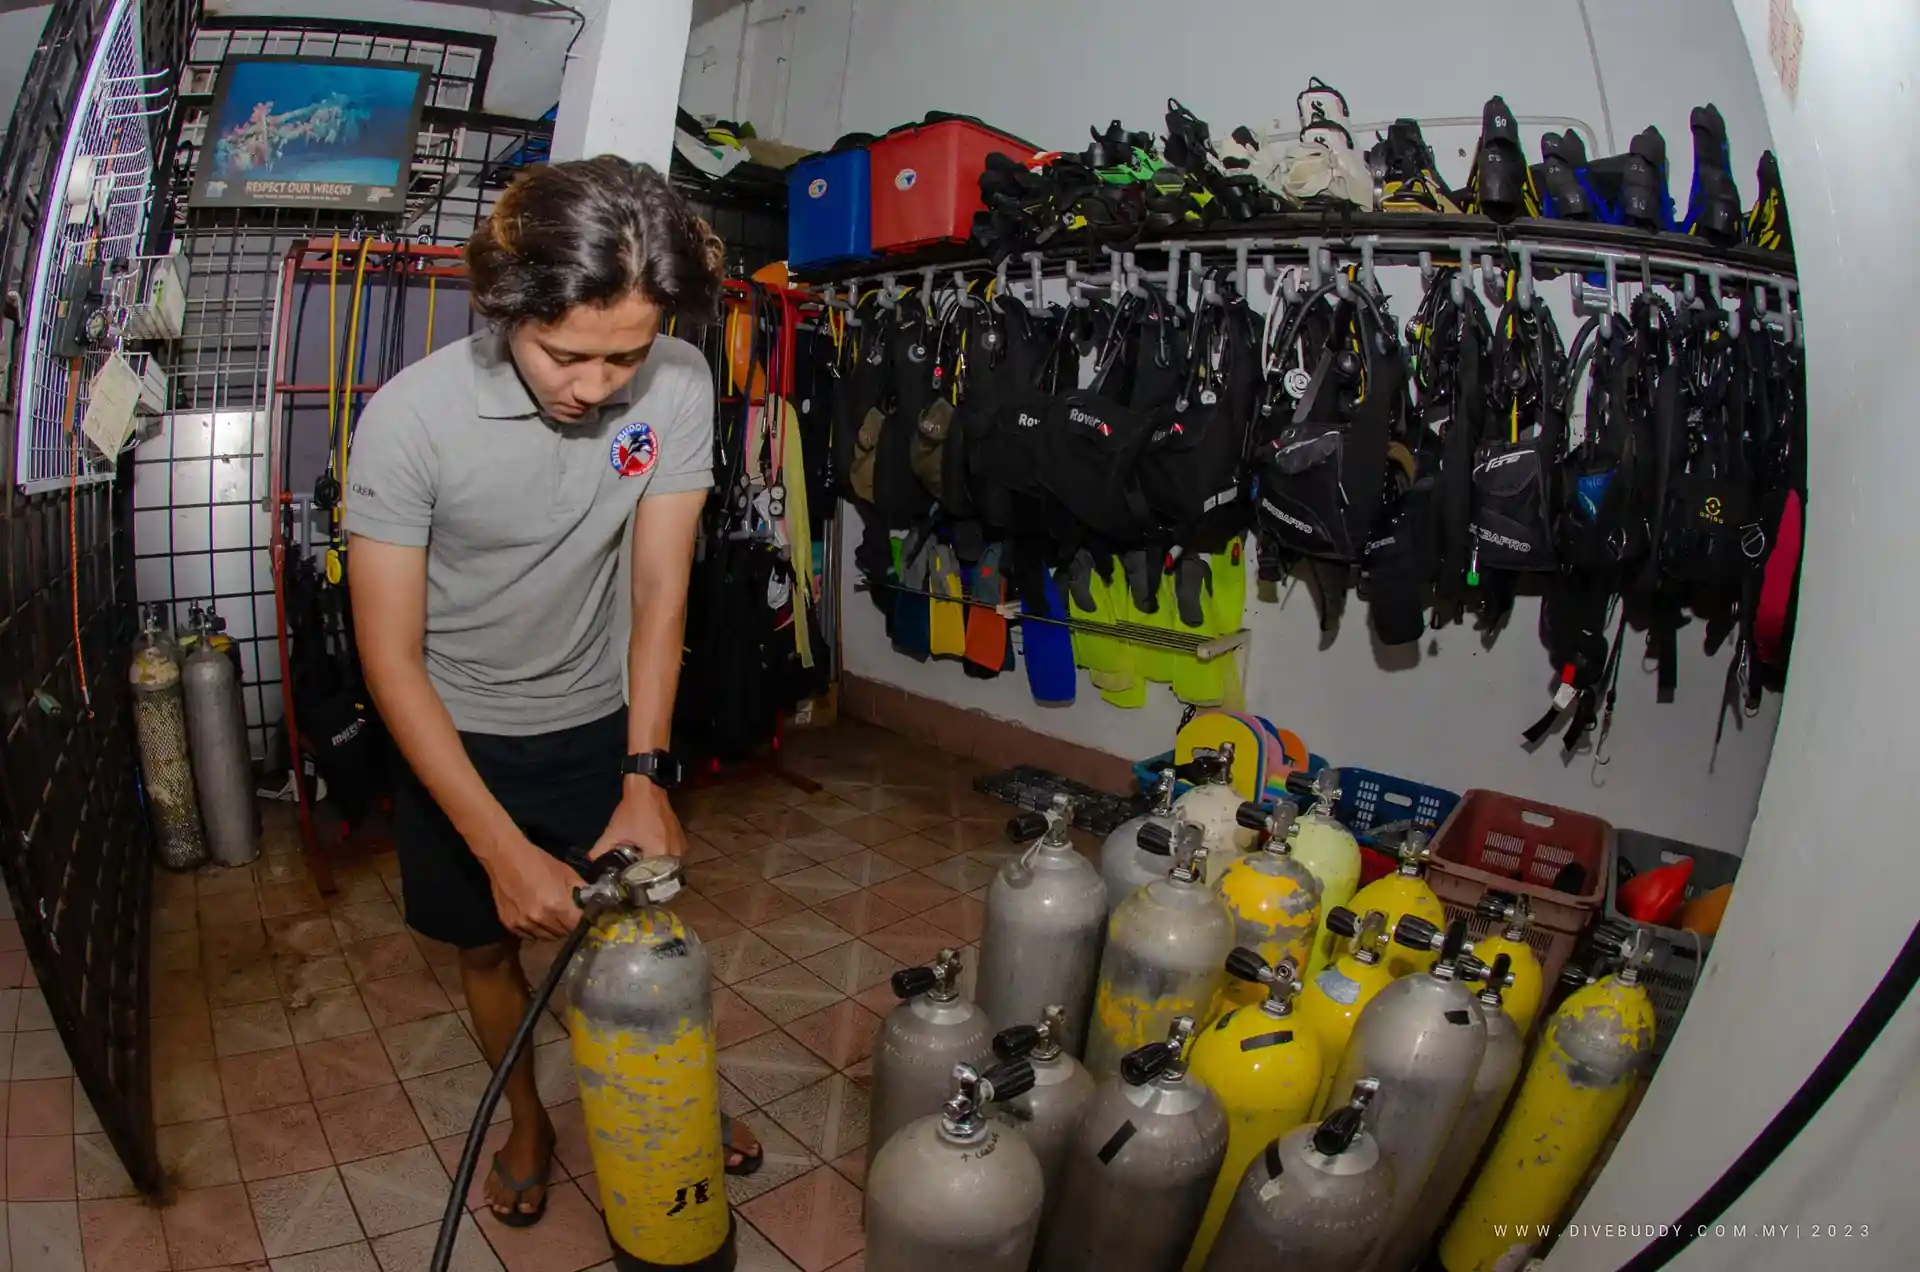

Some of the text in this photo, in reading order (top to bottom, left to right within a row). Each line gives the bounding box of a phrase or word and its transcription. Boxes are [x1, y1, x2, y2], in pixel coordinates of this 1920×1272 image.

[245, 180, 285, 194] RESPECT
[288, 182, 310, 195] OUR
[313, 184, 353, 197] WRECKS
[1069, 407, 1100, 428] Rover
[611, 442, 621, 467] DIVE
[616, 423, 649, 441] BUDDY
